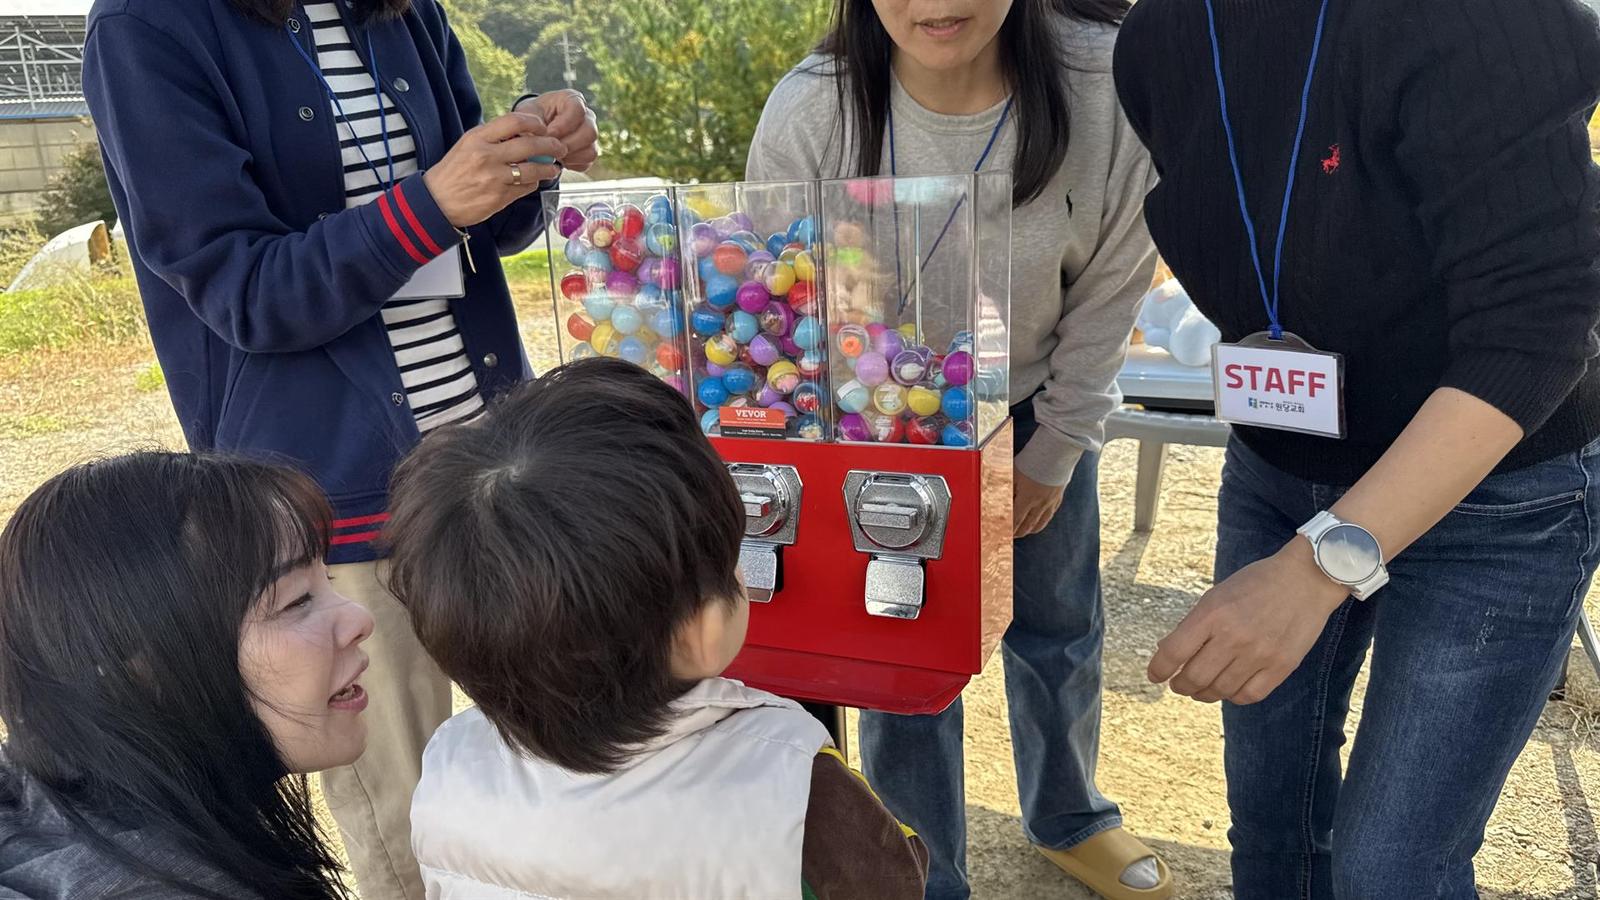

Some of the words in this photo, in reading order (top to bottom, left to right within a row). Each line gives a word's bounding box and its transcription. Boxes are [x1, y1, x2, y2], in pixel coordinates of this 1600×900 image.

[1225, 364, 1326, 398] STAFF
[1275, 402, 1305, 413] 원당교회
[735, 409, 767, 418] VEVOR
